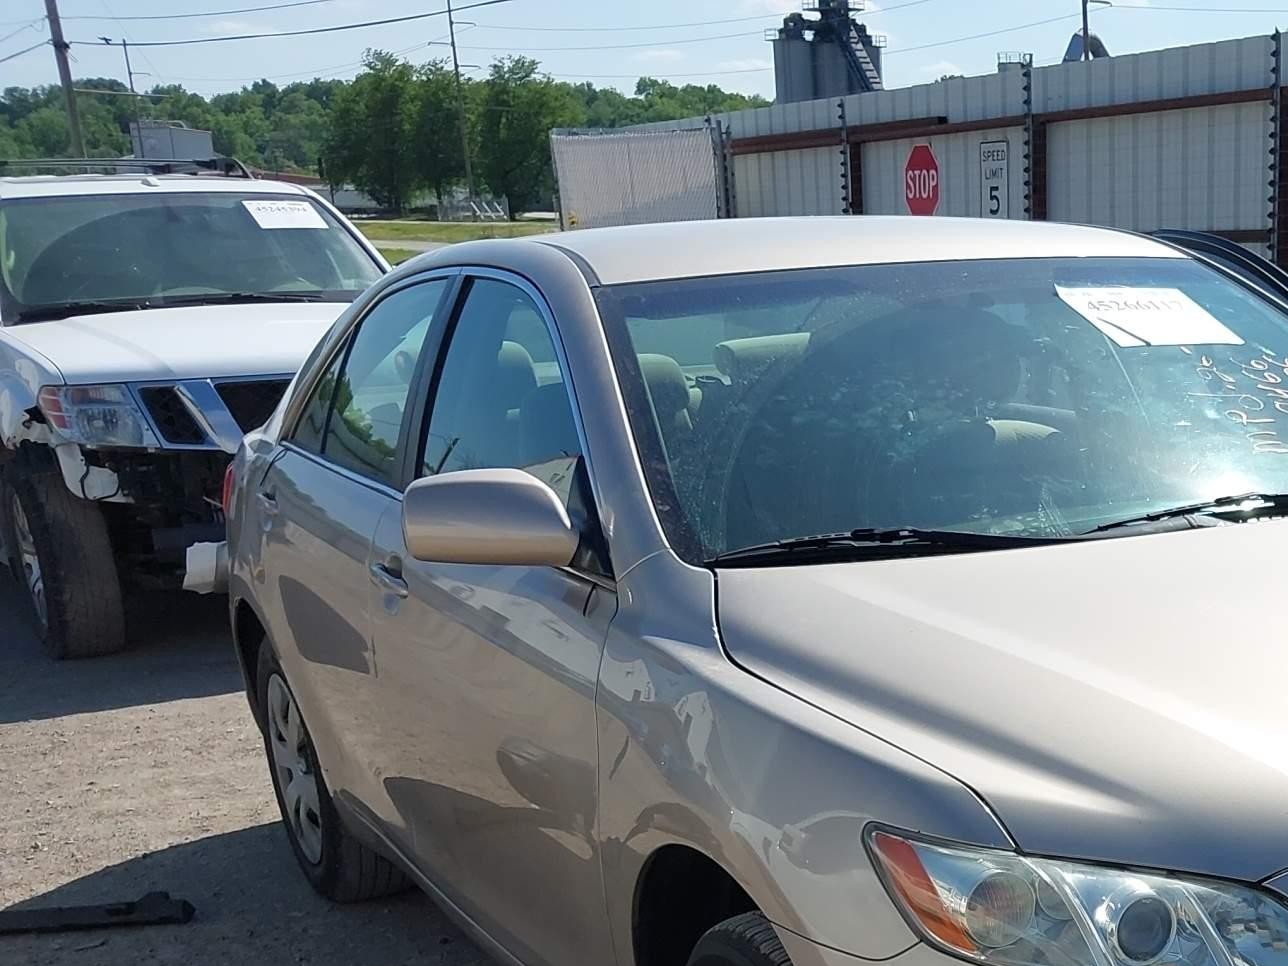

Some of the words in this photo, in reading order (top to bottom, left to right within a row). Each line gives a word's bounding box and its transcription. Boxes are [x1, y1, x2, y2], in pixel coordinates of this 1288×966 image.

[982, 149, 1006, 162] SPEED
[906, 169, 938, 199] STOP
[984, 167, 1004, 180] LIMIT
[989, 186, 1001, 216] 5
